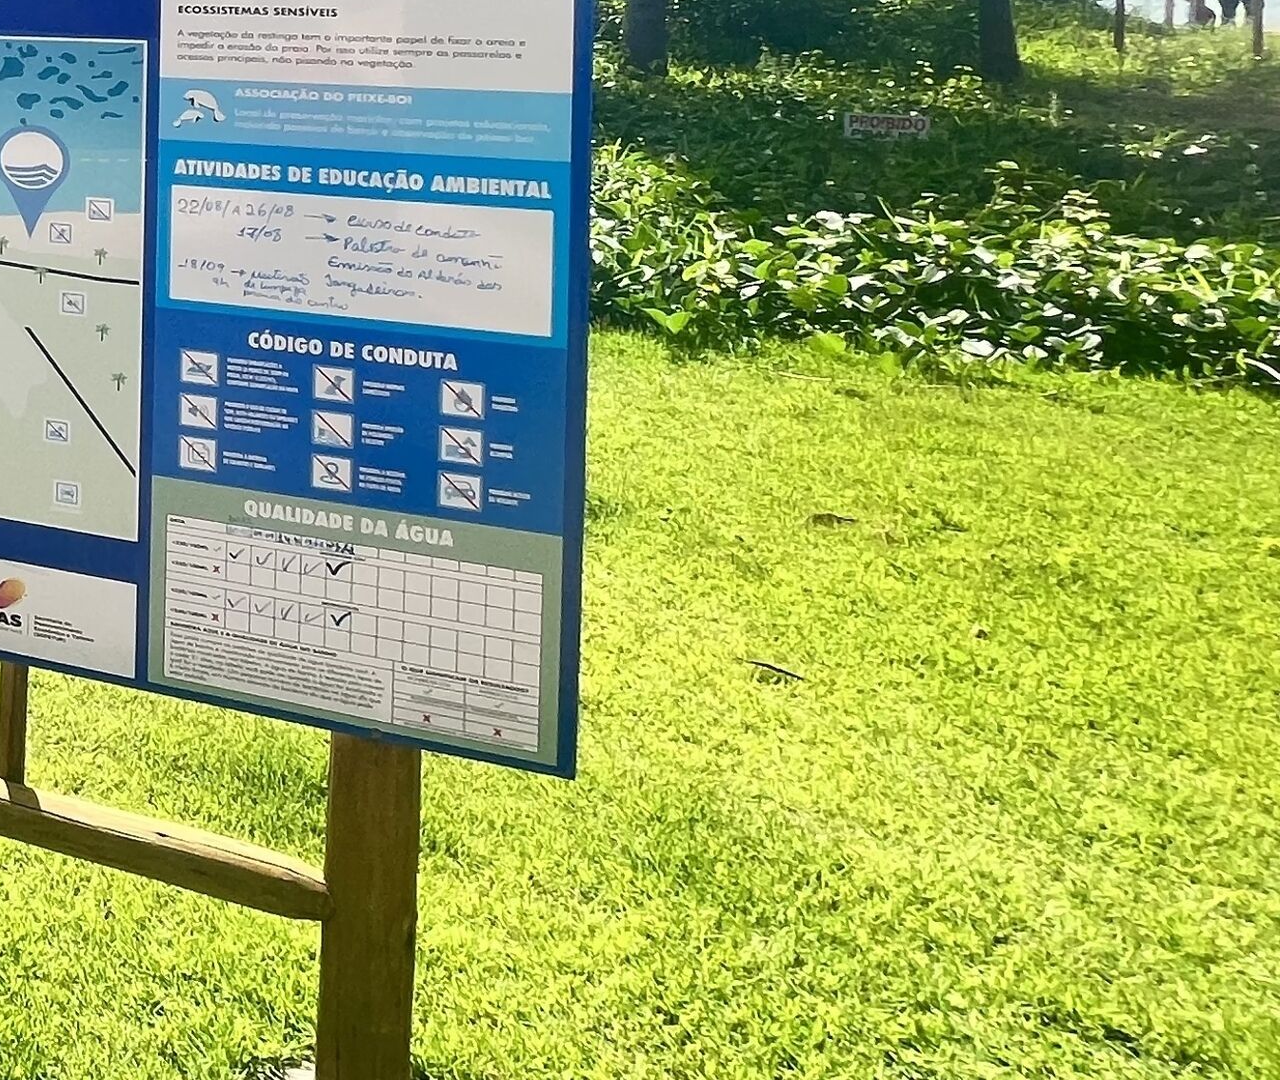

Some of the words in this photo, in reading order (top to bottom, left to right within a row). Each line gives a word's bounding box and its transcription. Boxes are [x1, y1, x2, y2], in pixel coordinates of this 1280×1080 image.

[177, 5, 268, 15] ECOSSISTEMAS
[273, 5, 337, 17] SENSÍVEIS
[173, 158, 281, 181] ATIVIDADES
[287, 165, 312, 183] DE
[318, 167, 424, 193] EDUCAÇÃO
[430, 175, 551, 199] AMBIENTAL
[248, 329, 322, 355] CÓDIGO
[329, 340, 354, 359] DE
[361, 344, 457, 371] CONDUTA
[244, 499, 353, 530] QUALIDADE
[360, 517, 388, 537] DA
[394, 519, 453, 547] ÁGUA
